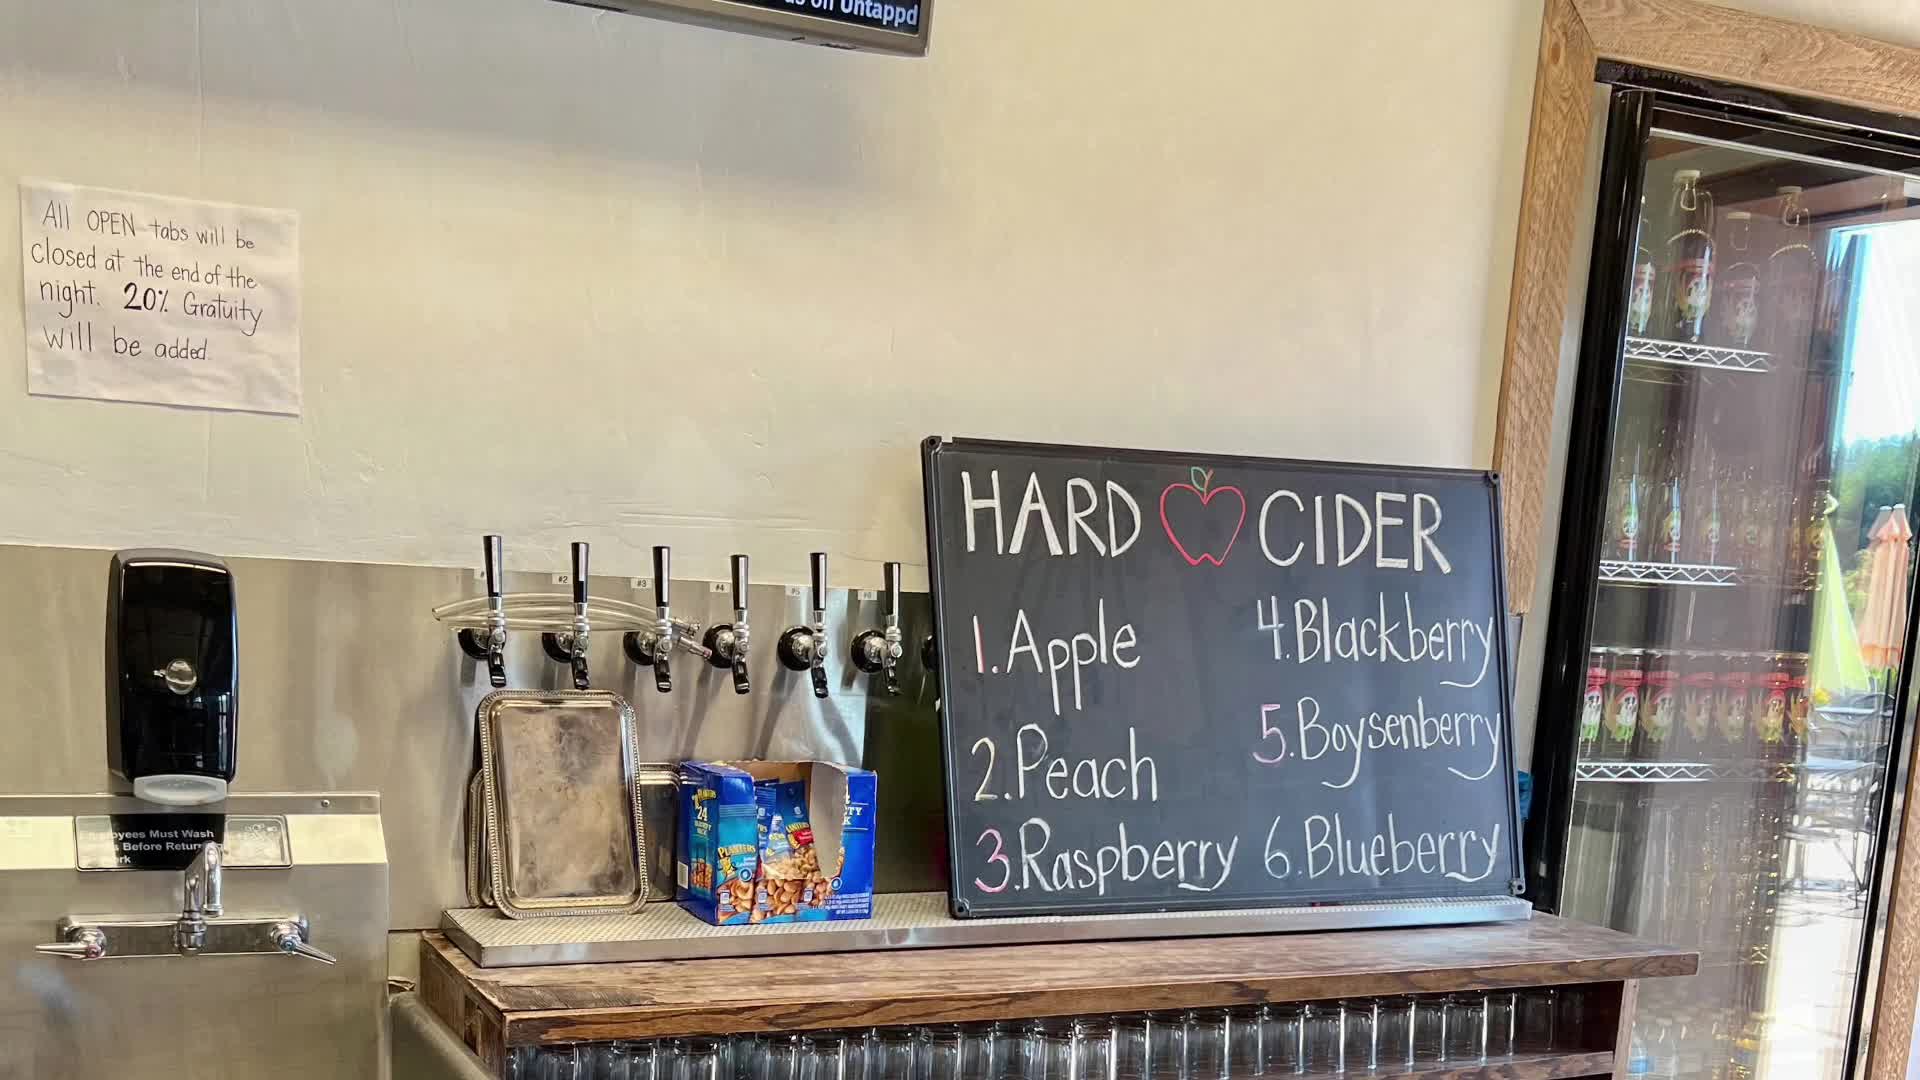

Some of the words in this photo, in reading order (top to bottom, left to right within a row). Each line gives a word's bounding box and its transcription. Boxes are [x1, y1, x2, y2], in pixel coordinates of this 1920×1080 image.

[810, 0, 834, 11] on
[840, 0, 919, 27] Untappd
[42, 200, 70, 231] All
[86, 209, 136, 237] OPEN
[147, 221, 189, 242] tabs
[196, 228, 225, 247] will
[236, 230, 255, 250] be
[105, 250, 125, 273] at
[133, 255, 164, 279] the
[171, 262, 200, 283] end
[204, 264, 222, 284] of
[226, 267, 257, 289] the
[123, 282, 169, 312] 20%
[183, 291, 263, 337] Gratuity
[43, 321, 93, 352] will
[113, 326, 142, 357] be
[961, 469, 1141, 557] HARD
[1258, 489, 1451, 574] CIDER
[558, 575, 569, 584] #2
[637, 579, 647, 588] #3
[123, 842, 163, 851] Before
[149, 830, 179, 839] Must
[181, 830, 215, 839] Wash
